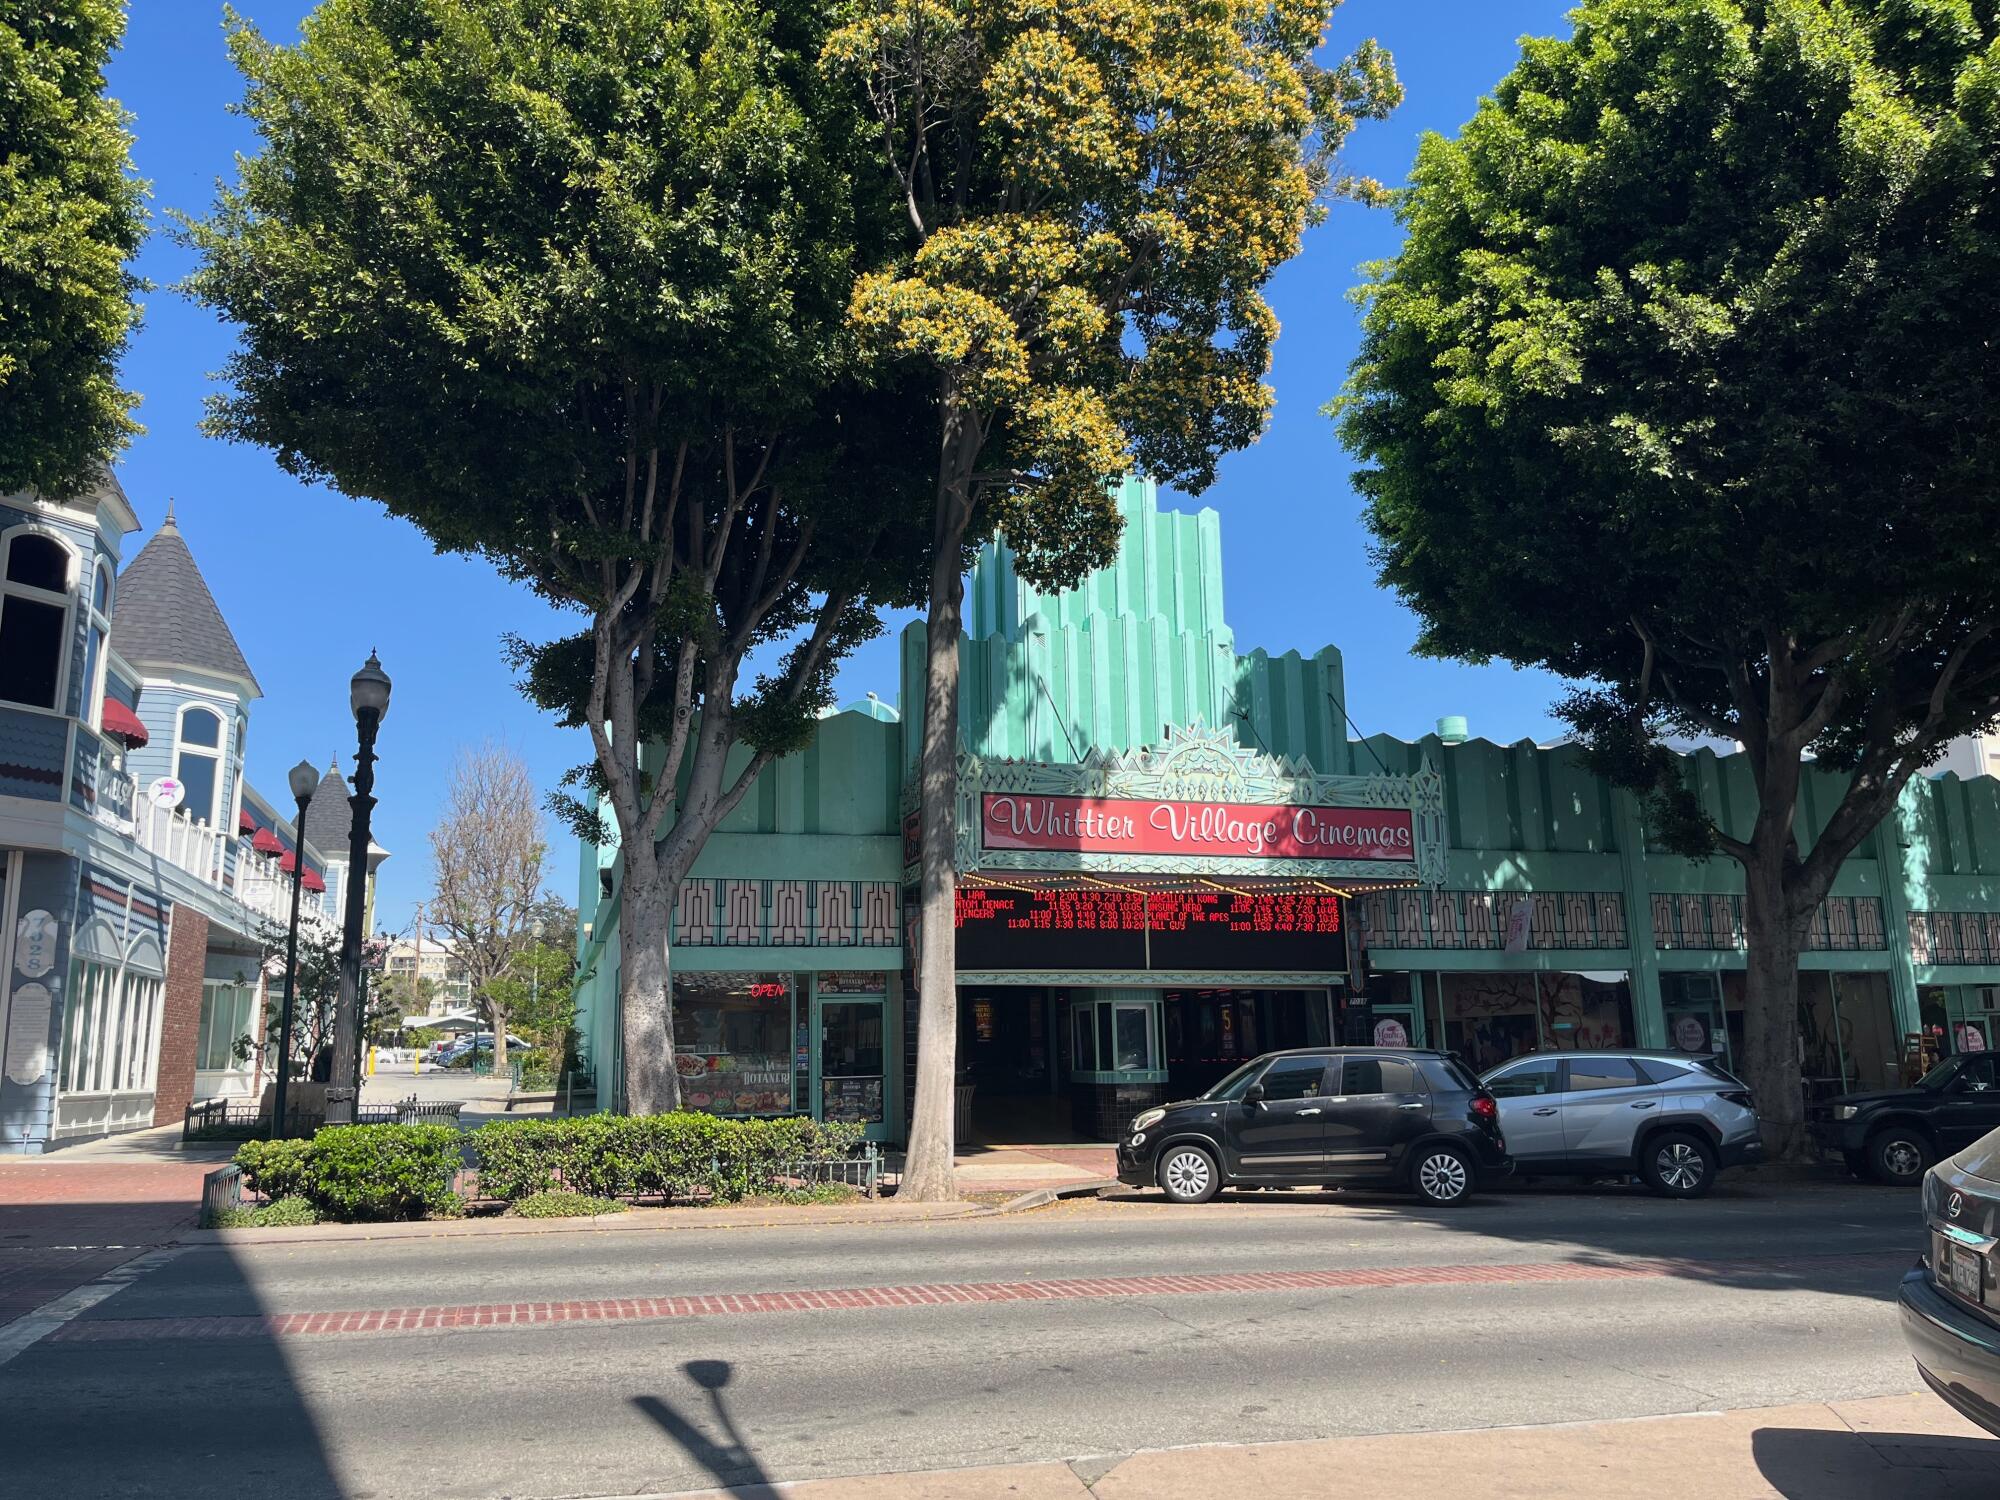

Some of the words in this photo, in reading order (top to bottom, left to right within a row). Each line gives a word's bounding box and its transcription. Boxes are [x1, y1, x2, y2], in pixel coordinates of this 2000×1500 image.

[990, 797, 1135, 840] Whittier
[1149, 804, 1277, 854] Village
[1292, 808, 1410, 849] Cinemas
[1060, 892, 1078, 901] 2:00
[1082, 892, 1100, 901] 4:30
[1105, 893, 1121, 901] 7:10
[1126, 893, 1143, 902] 9:50
[1198, 895, 1218, 903] KONG
[1278, 896, 1295, 904] 4:25
[1299, 896, 1316, 904] 7:05
[982, 900, 1014, 909] MENACE
[1075, 901, 1093, 910] 3:20
[1098, 902, 1115, 910] 7:00
[1120, 902, 1142, 910] 10:05
[1182, 903, 1202, 911] HERO
[1275, 905, 1292, 913] 4:35
[1296, 905, 1313, 913] 7:20
[1317, 906, 1338, 914] 10:05
[1030, 910, 1052, 918] 11:00
[1056, 910, 1073, 919] 1:50
[1078, 911, 1095, 919] 4:40
[1100, 911, 1118, 919] 7:30
[1122, 911, 1144, 919] 10:20
[1147, 912, 1174, 920] PLANET
[1179, 912, 1188, 920] OF
[1192, 912, 1205, 921] THE
[1210, 913, 1229, 921] APES
[1278, 914, 1294, 922] 3:30
[1298, 914, 1315, 922] 7:00
[1319, 914, 1339, 922] 10:15
[1008, 919, 1030, 928] 11:00
[1034, 919, 1050, 928] 1:15
[1056, 920, 1073, 928] 3:30
[1100, 920, 1118, 928] 8:00
[1122, 920, 1144, 928] 10:20
[1148, 921, 1165, 929] FALL
[1170, 921, 1186, 929] GUY
[1230, 922, 1251, 930] 11:00
[1255, 923, 1271, 931] 1:50
[1275, 923, 1292, 931] 4:40
[1296, 923, 1313, 931] 7:30
[1317, 924, 1338, 932] 10:20
[751, 984, 785, 999] OPEN
[766, 1060, 775, 1073] LA
